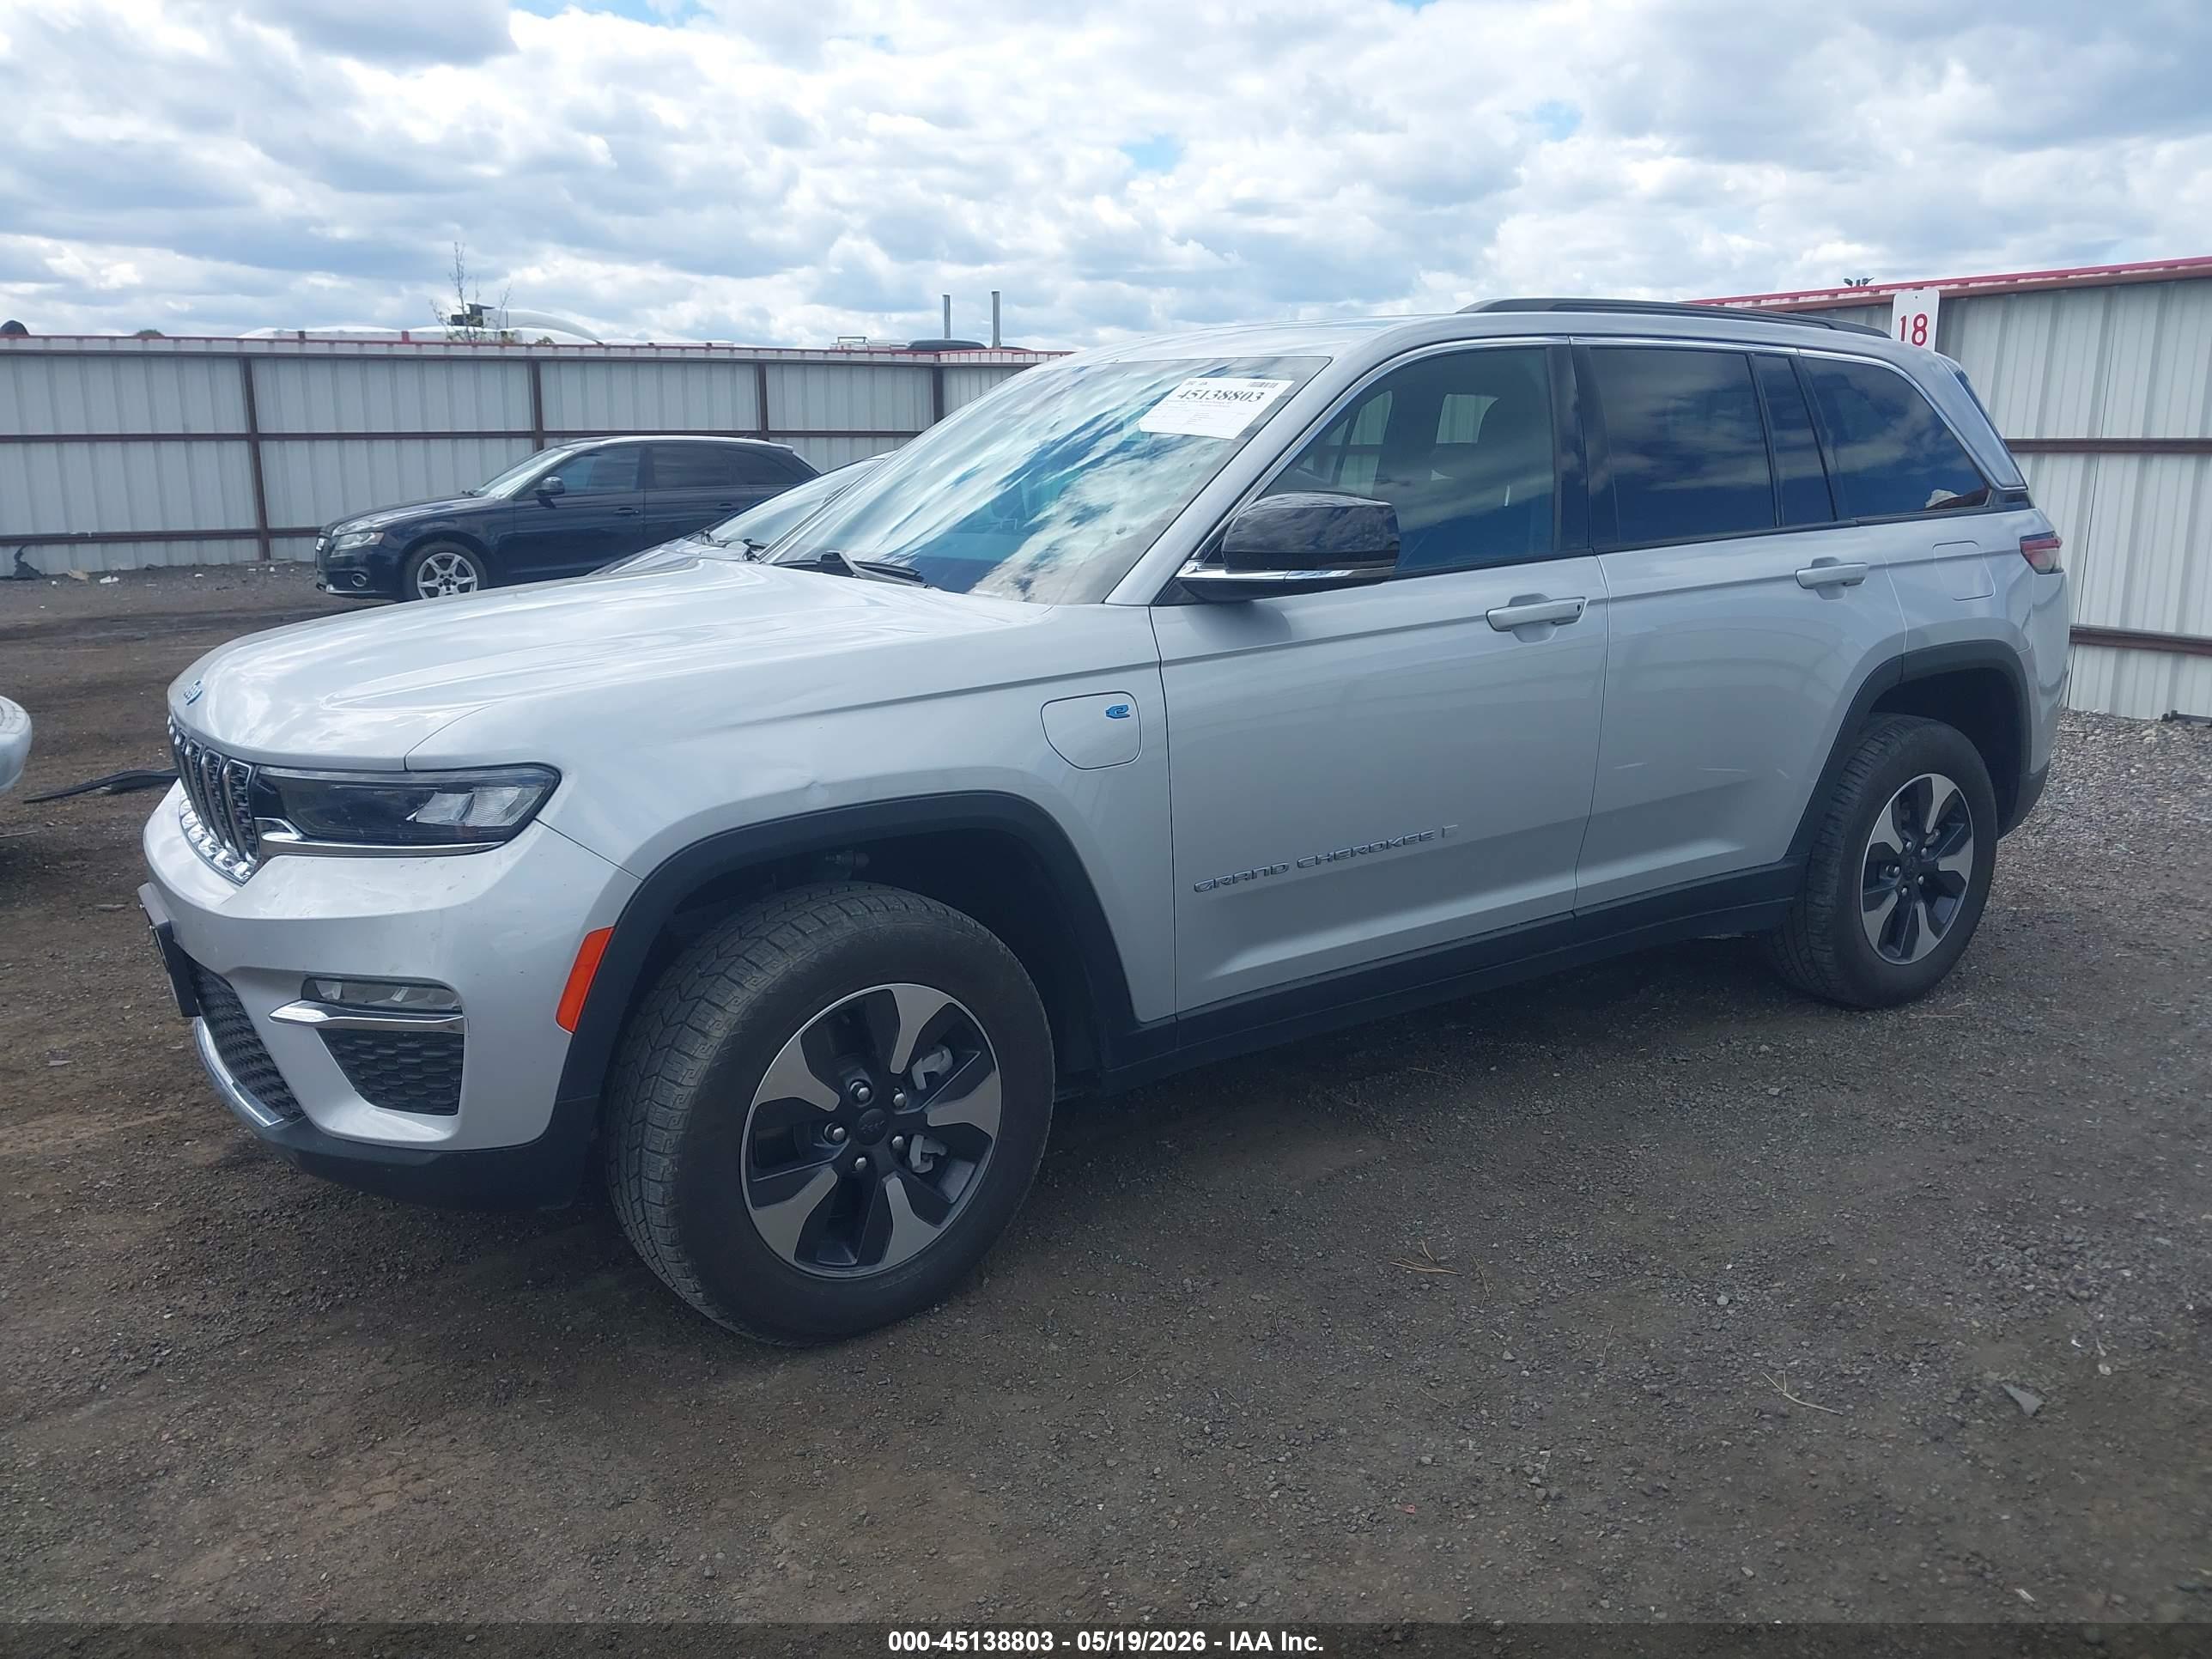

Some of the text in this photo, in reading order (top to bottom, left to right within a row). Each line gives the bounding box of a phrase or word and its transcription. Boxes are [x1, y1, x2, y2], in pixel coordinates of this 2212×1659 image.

[1899, 313, 1929, 347] 18
[1177, 389, 1265, 403] 45138803
[1194, 830, 1436, 893] GRAND CHEROKEE
